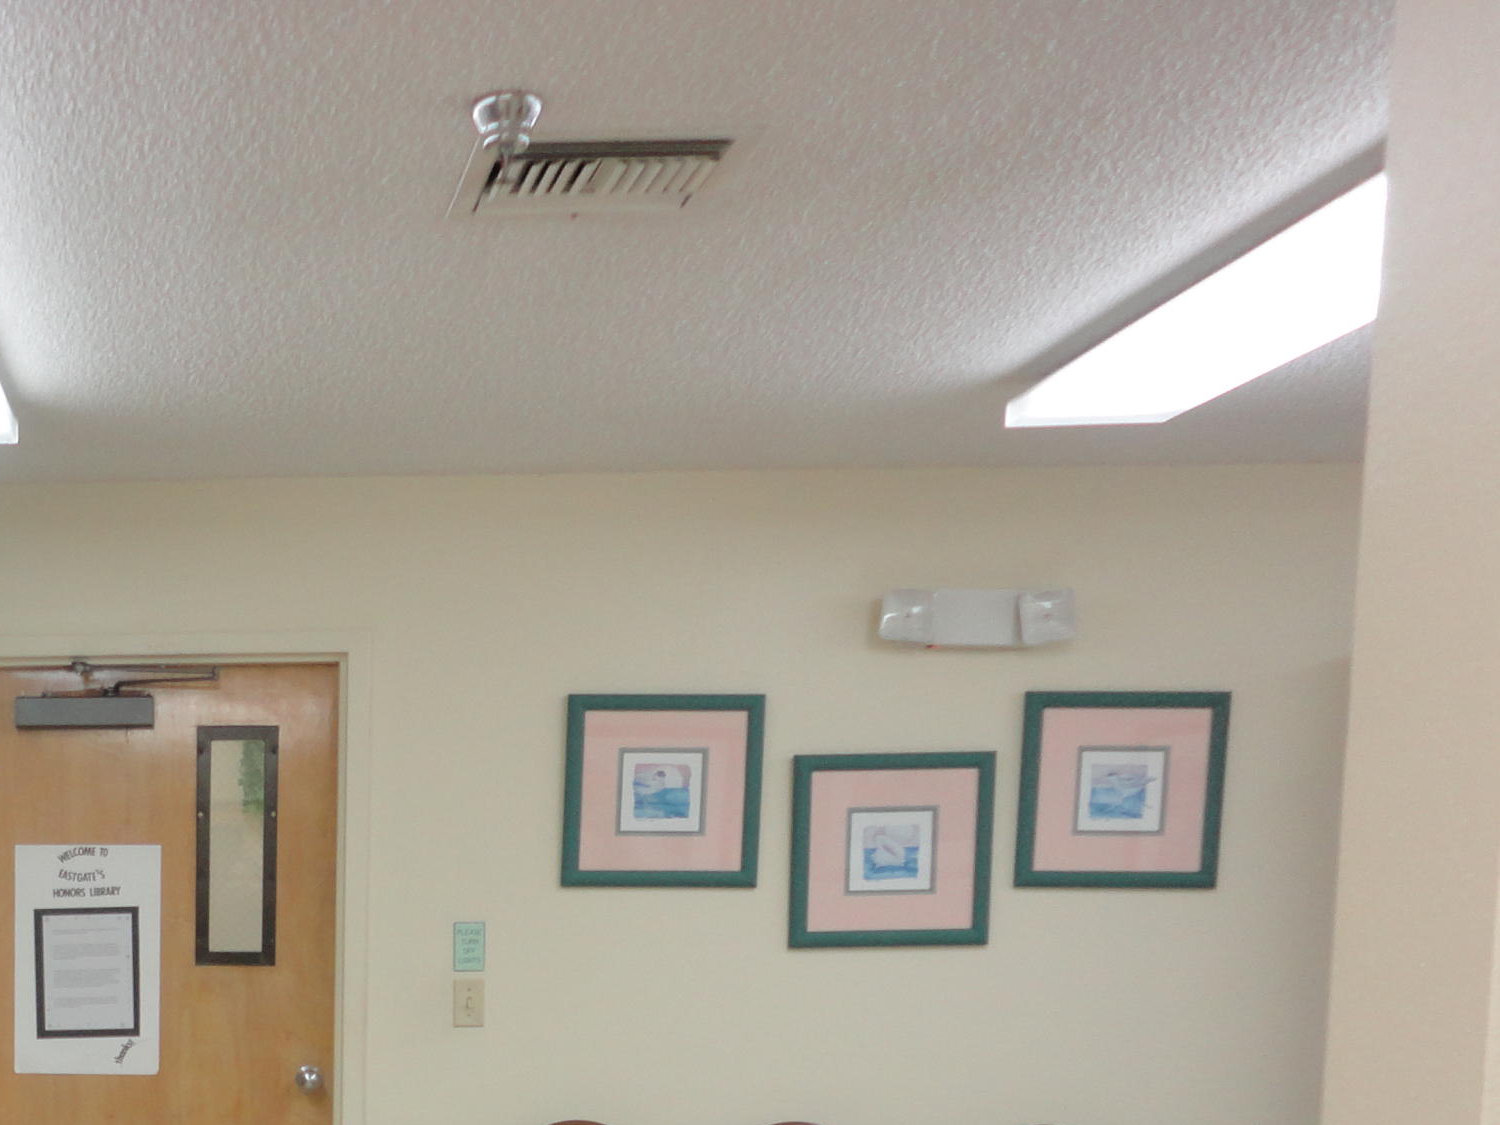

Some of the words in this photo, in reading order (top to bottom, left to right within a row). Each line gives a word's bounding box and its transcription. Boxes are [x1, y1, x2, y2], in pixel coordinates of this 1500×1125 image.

[58, 847, 96, 863] WELCOME
[100, 847, 109, 858] TO
[58, 868, 105, 882] EASTGATE'S
[53, 888, 86, 898] HONORS
[90, 886, 121, 897] LIBRARY
